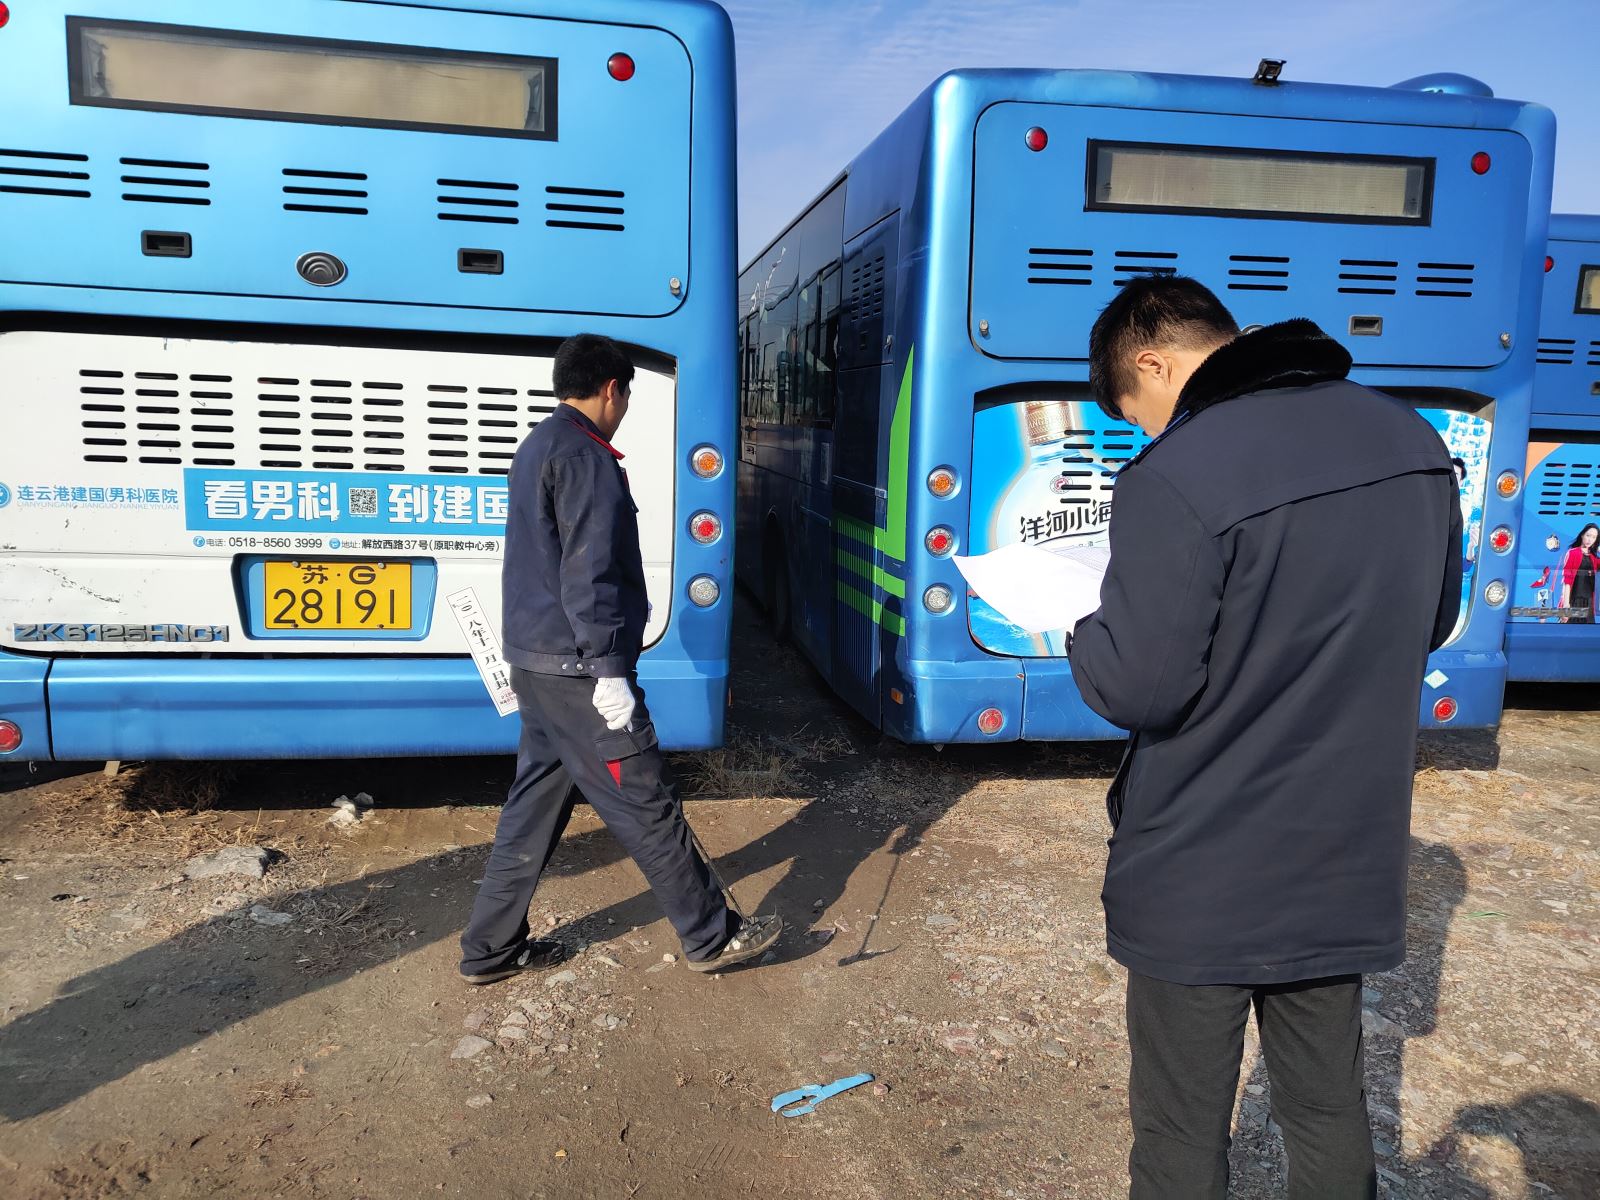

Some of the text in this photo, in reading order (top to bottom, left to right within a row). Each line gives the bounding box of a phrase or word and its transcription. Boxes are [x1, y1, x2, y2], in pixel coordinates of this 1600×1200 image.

[17, 485, 178, 504] 连云港建国(男科)医院
[203, 480, 509, 524] 看男科 到建国
[228, 537, 291, 548] 0518-8560
[294, 538, 322, 548] 3999
[272, 588, 395, 624] 28191
